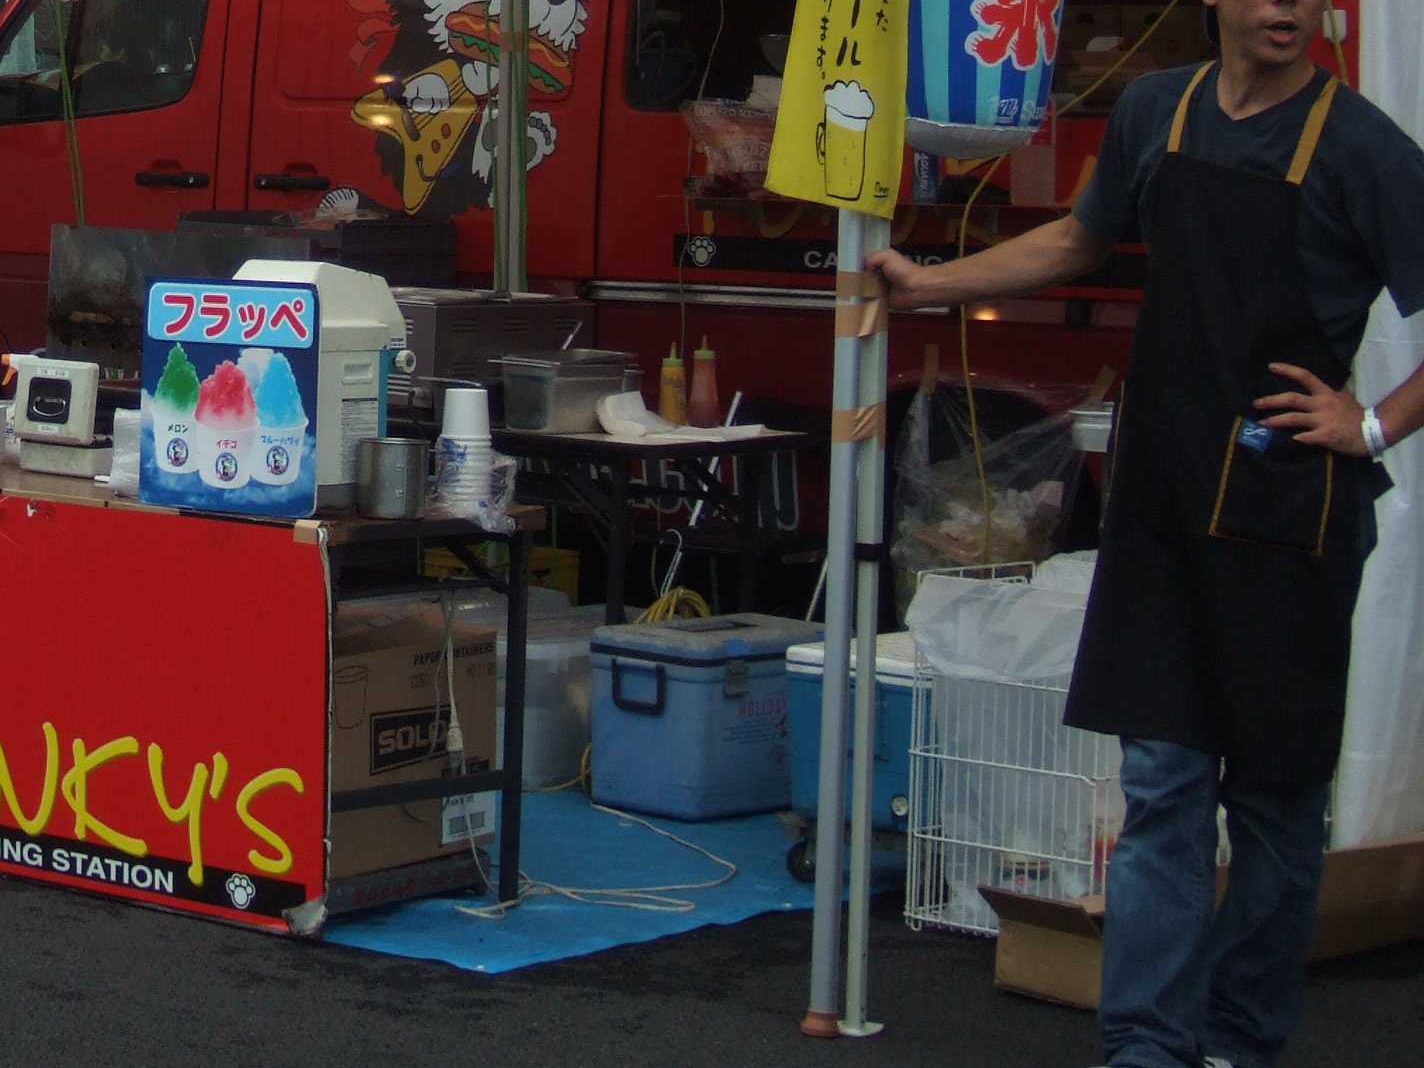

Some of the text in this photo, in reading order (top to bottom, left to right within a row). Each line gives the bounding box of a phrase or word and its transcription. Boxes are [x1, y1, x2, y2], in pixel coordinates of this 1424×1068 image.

[163, 293, 308, 341] フラッペ
[167, 424, 189, 433] メロン
[216, 439, 238, 449] イチゴ
[51, 848, 174, 893] STATION
